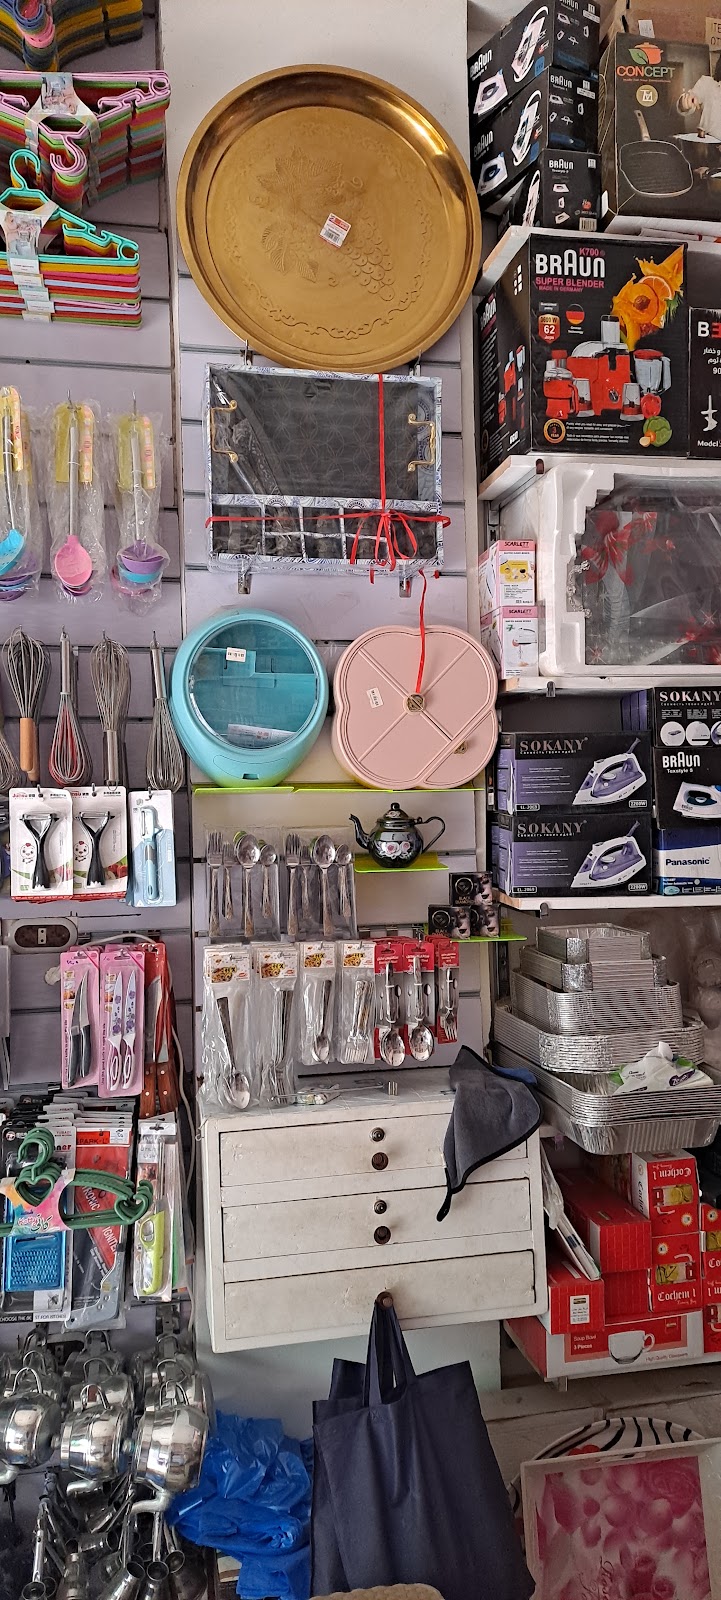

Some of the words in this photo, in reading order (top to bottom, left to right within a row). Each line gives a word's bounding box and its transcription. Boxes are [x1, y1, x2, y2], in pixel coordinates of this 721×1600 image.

[469, 49, 492, 79] BRAUN
[616, 65, 676, 78] CONCEPT
[550, 74, 573, 89] BRAUN
[548, 158, 574, 170] BRAUN
[579, 247, 599, 257] K700
[535, 249, 606, 279] BRAUN
[535, 277, 565, 287] SUPER
[566, 278, 605, 289] BLENDER
[543, 324, 556, 335] 62
[659, 690, 721, 702] SOKANY
[519, 738, 585, 752] SOKANY
[662, 751, 700, 768] BRAUN
[517, 822, 584, 836] SOKANY
[665, 857, 710, 866] Panasonic
[659, 1167, 692, 1180] Cochem
[657, 1288, 690, 1302] Cochem
